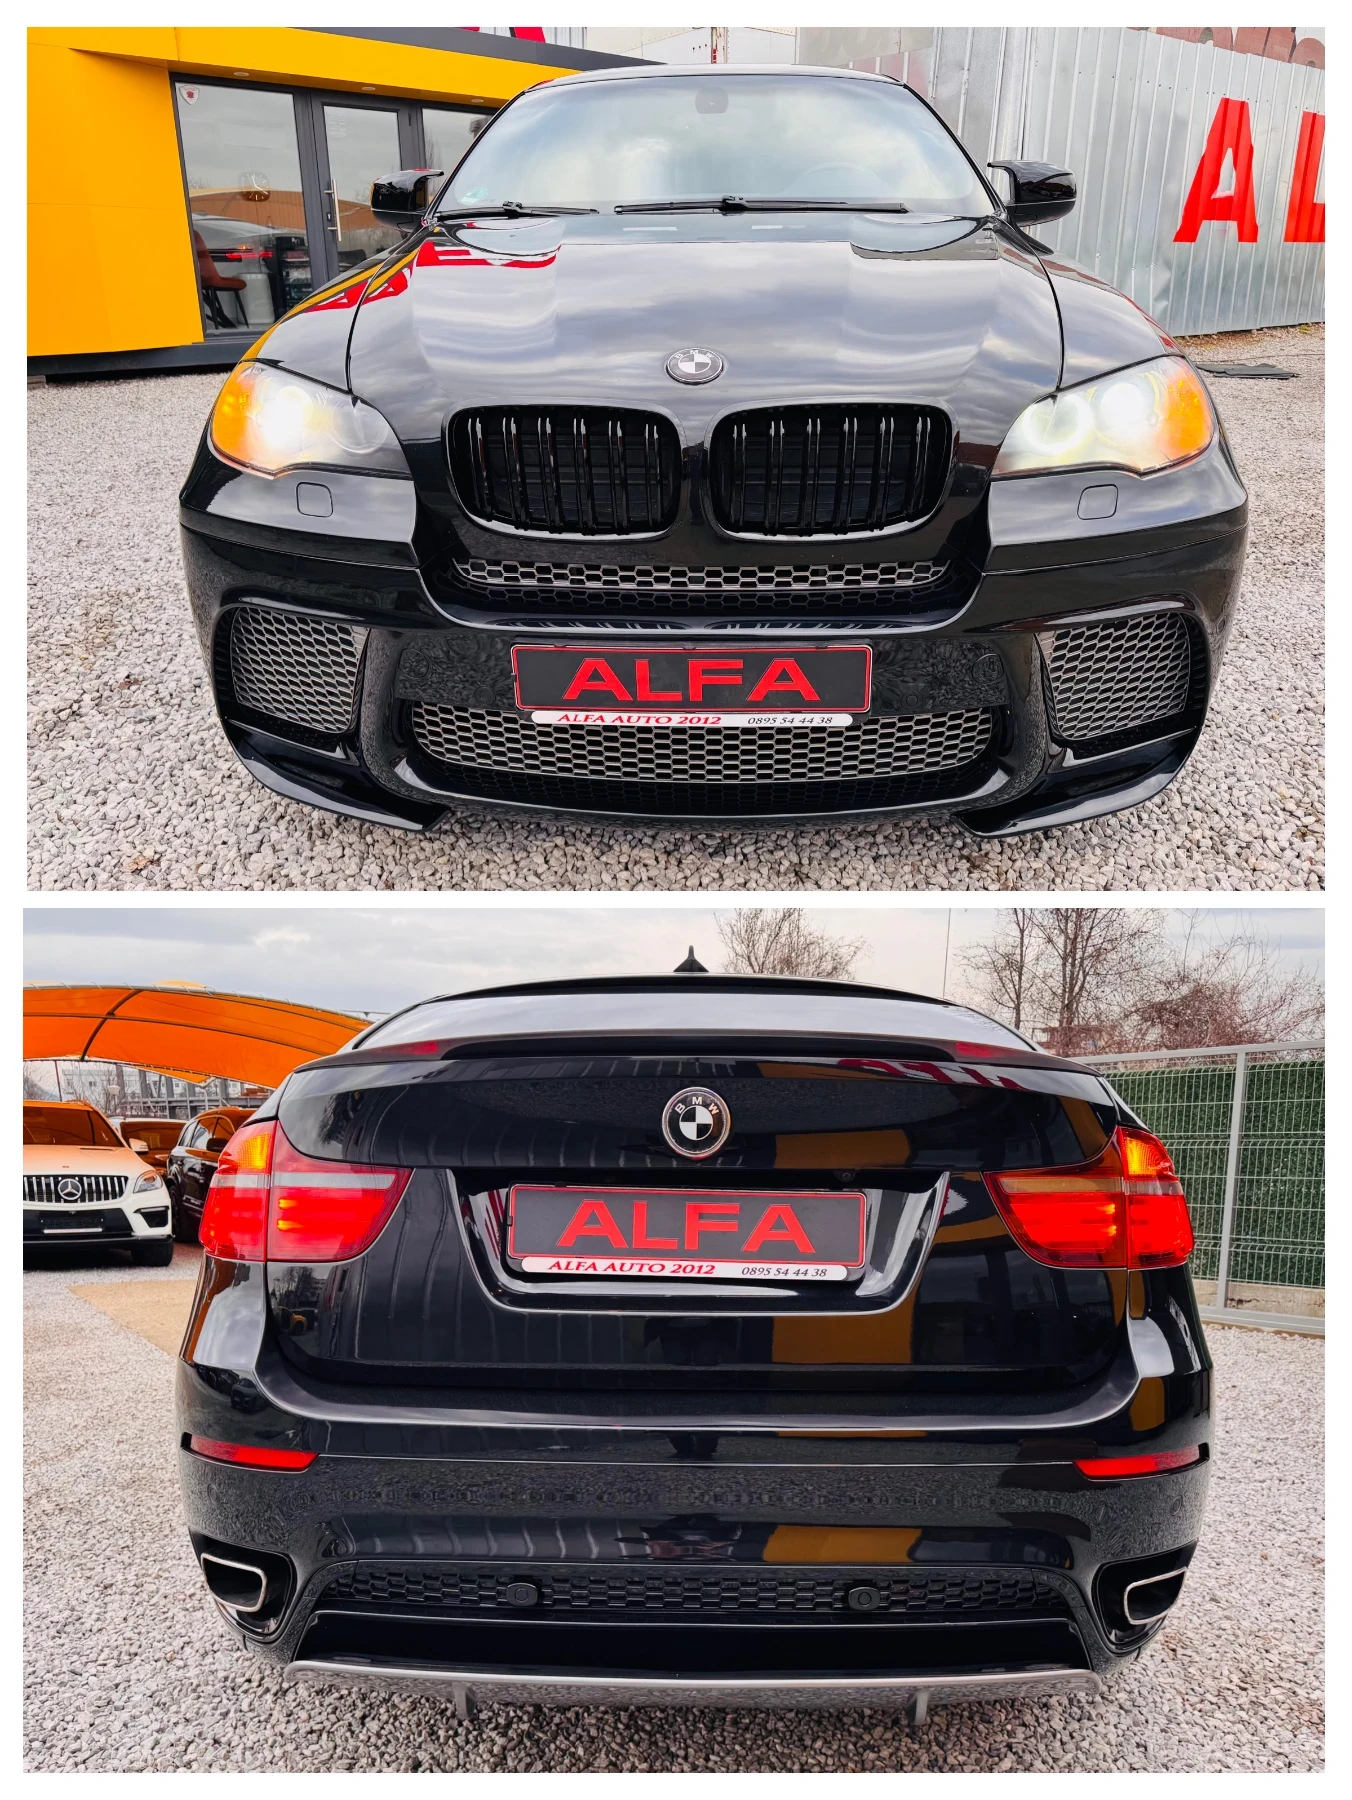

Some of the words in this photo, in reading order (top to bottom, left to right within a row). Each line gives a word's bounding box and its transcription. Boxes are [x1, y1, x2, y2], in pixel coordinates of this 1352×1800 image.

[675, 350, 714, 359] BMW
[562, 657, 821, 702] ALFA
[557, 713, 605, 723] ALFA
[612, 714, 673, 725] AUTO
[675, 715, 722, 725] 2012
[747, 716, 777, 725] 0895
[779, 717, 795, 725] 54
[797, 717, 815, 725] 44
[816, 717, 833, 725] 38
[674, 1096, 720, 1115] BMW
[556, 1198, 816, 1254] ALFA
[548, 1260, 599, 1273] ALFA
[604, 1262, 666, 1274] AUTO
[669, 1264, 716, 1275] 2012
[741, 1266, 772, 1276] 0895
[773, 1267, 790, 1277] 54
[791, 1268, 810, 1277] 44
[810, 1269, 828, 1278] 38
